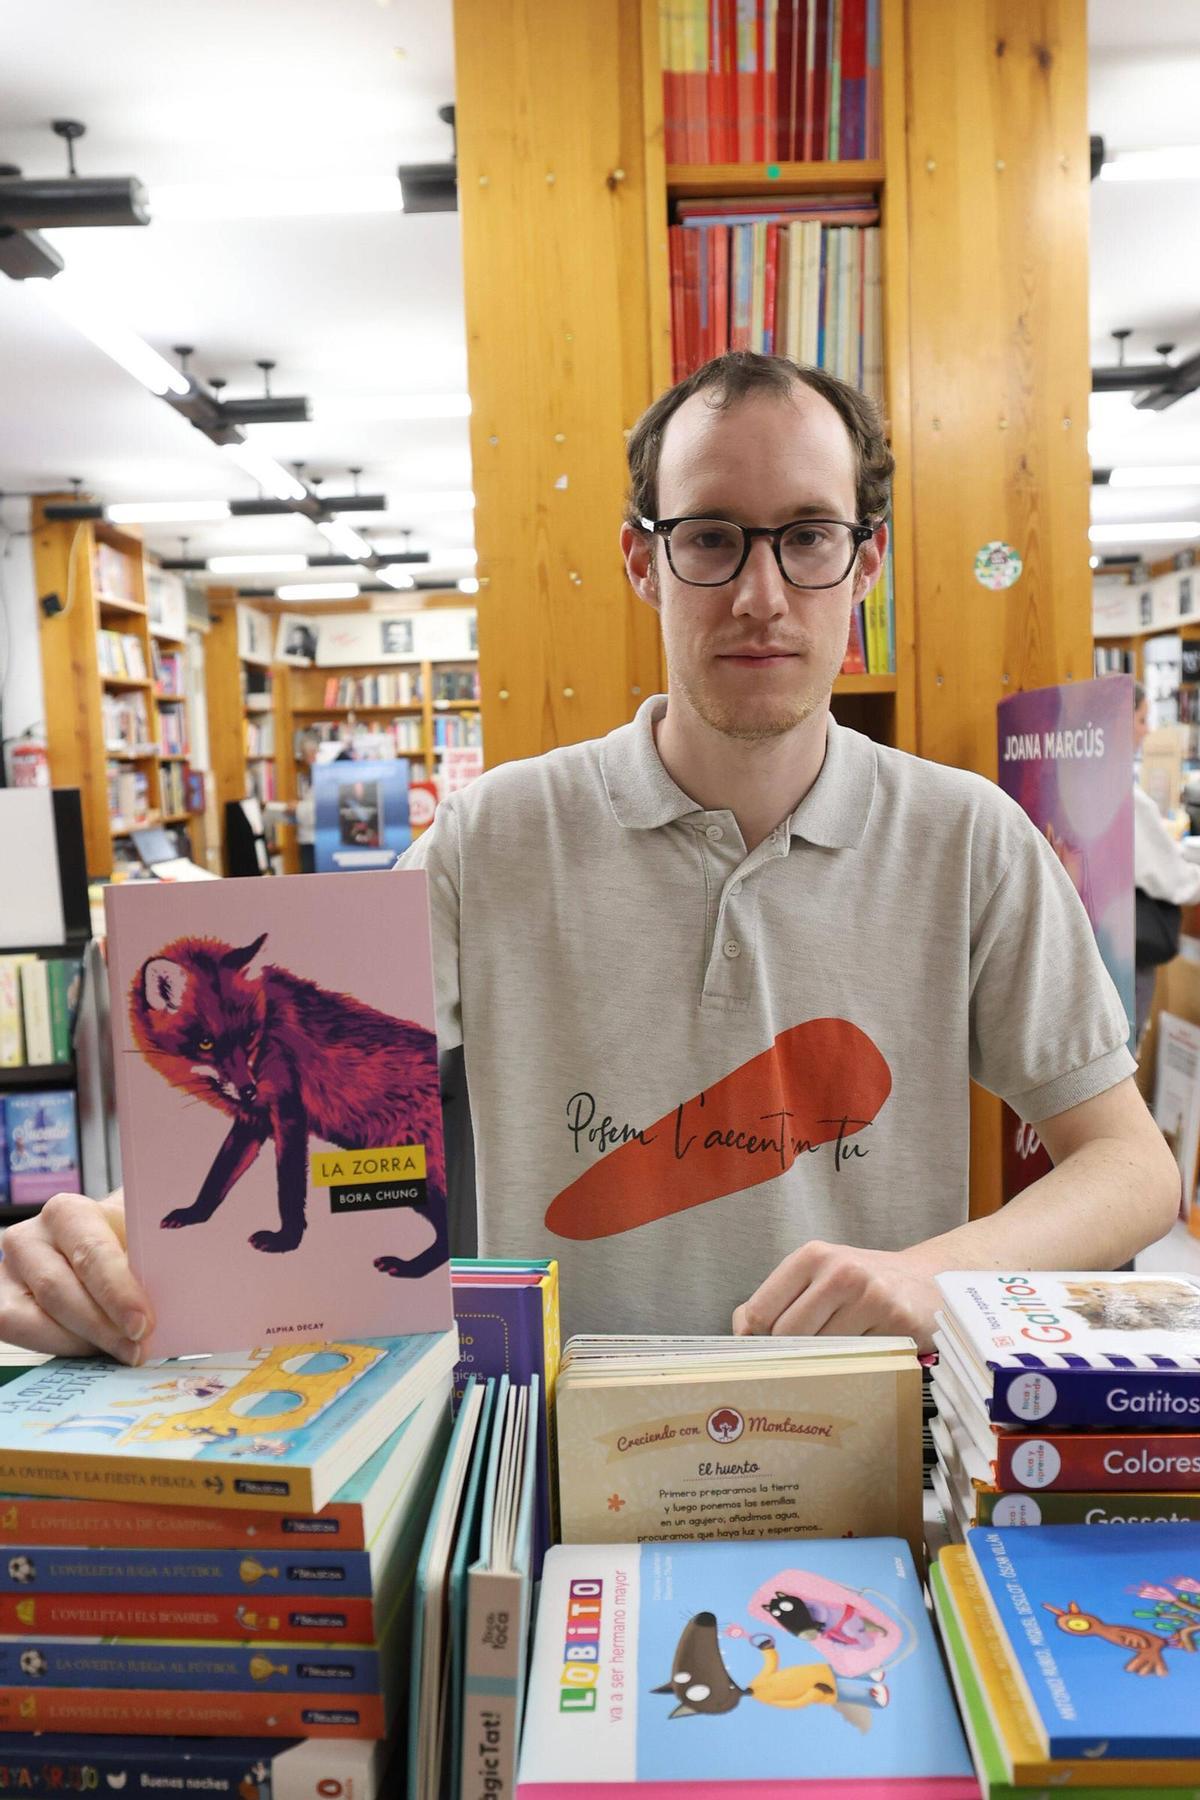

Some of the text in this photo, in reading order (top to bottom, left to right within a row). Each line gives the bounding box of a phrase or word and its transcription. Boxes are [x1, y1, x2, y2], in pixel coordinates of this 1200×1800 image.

[1004, 722, 1104, 761] JOANA MARCÚS
[566, 1091, 657, 1153] Posem
[321, 1156, 416, 1178] LA ZORRA
[339, 1187, 419, 1204] BORA CHUNG
[998, 1276, 1072, 1344] Gatitos
[266, 1322, 325, 1335] ALPHA DECAY
[1033, 1378, 1041, 1415] aprende
[1106, 1387, 1200, 1413] Gatitos
[617, 1416, 833, 1452] Creciendo con Montessori
[698, 1460, 760, 1476] El huerto
[1103, 1450, 1200, 1475] Colores
[72, 1470, 80, 1482] Y
[84, 1471, 99, 1483] LA
[104, 1472, 146, 1486] FIESTA
[150, 1474, 196, 1488] PIRATA
[659, 1483, 799, 1499] Primero preparamos la tierra
[664, 1496, 796, 1514] y luego ponemos las semillas
[136, 1519, 153, 1530] DE
[660, 1519, 672, 1527] en
[674, 1518, 686, 1526] un
[729, 1512, 773, 1523] añadimos
[775, 1511, 800, 1521] agua,
[637, 1531, 694, 1543] procuramos
[697, 1530, 714, 1540] que
[717, 1527, 740, 1538] haya
[742, 1526, 755, 1536] luz
[757, 1528, 765, 1537] y
[609, 1570, 630, 1723] va a ser hermano mayor
[155, 1707, 174, 1720] DE
[478, 1712, 503, 1800] agicTat!
[140, 1772, 229, 1790] Buenas noches
